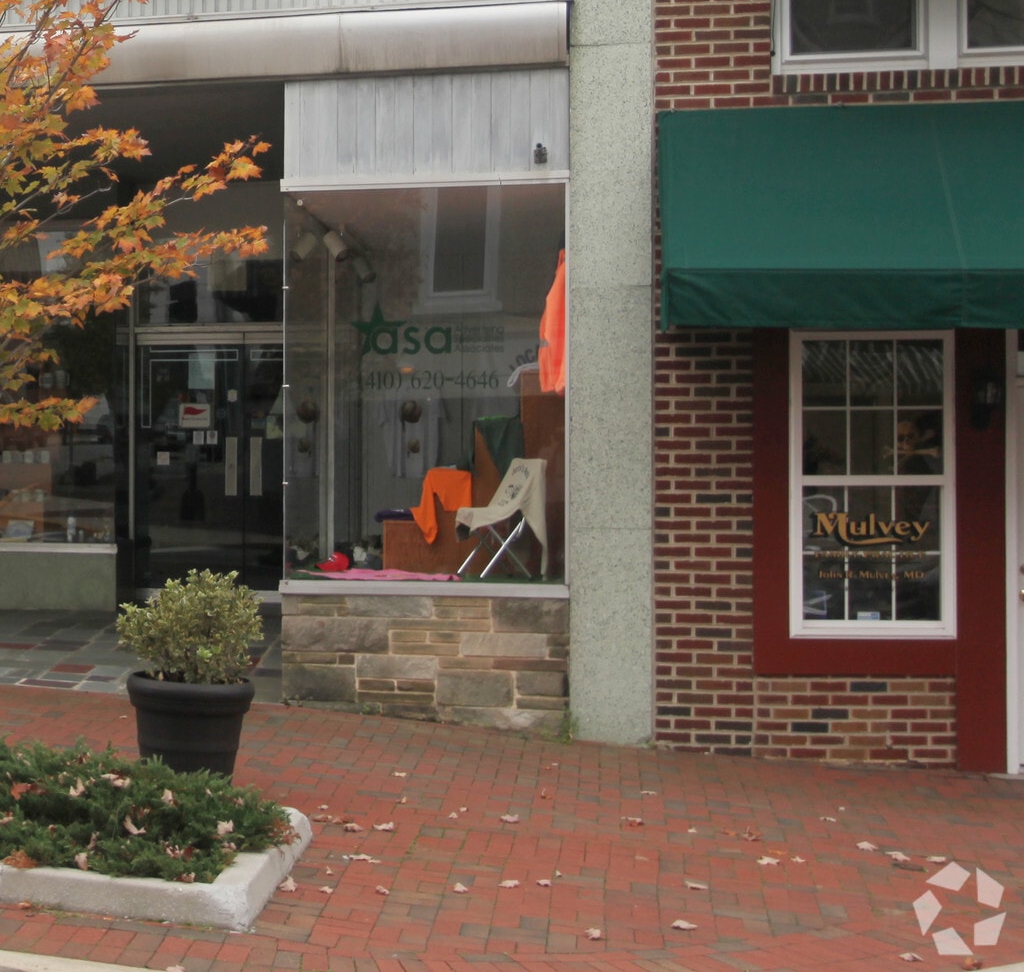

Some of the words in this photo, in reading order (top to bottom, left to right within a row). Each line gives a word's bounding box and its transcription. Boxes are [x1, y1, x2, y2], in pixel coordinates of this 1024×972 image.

[372, 326, 451, 354] asa
[410, 370, 499, 390] 620-4646
[813, 513, 930, 545] Mulvey
